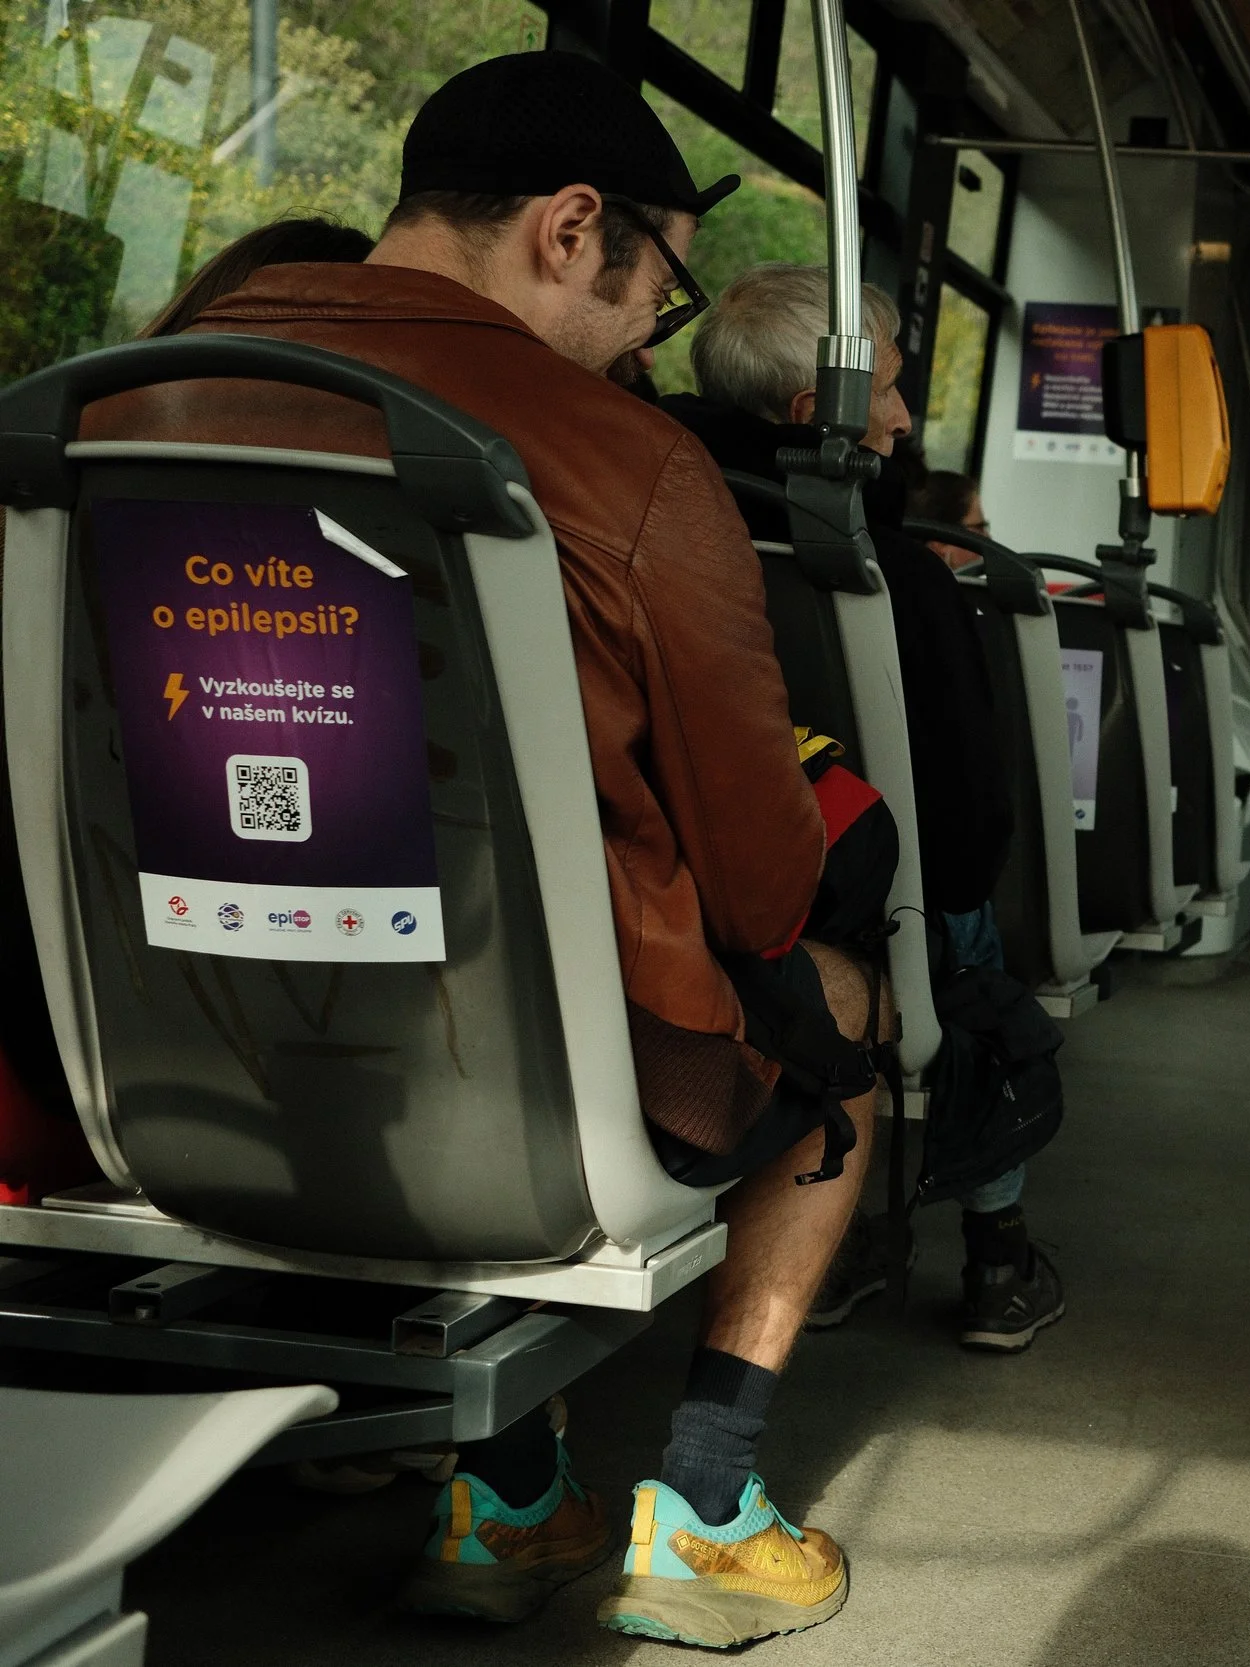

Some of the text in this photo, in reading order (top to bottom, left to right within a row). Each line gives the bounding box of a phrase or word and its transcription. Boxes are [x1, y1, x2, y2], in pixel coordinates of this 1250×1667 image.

[185, 555, 314, 588] Co víte
[153, 602, 360, 639] o epilepsii?
[199, 676, 355, 701] Vyzkoušejte se
[202, 703, 354, 725] v našem kvízu.
